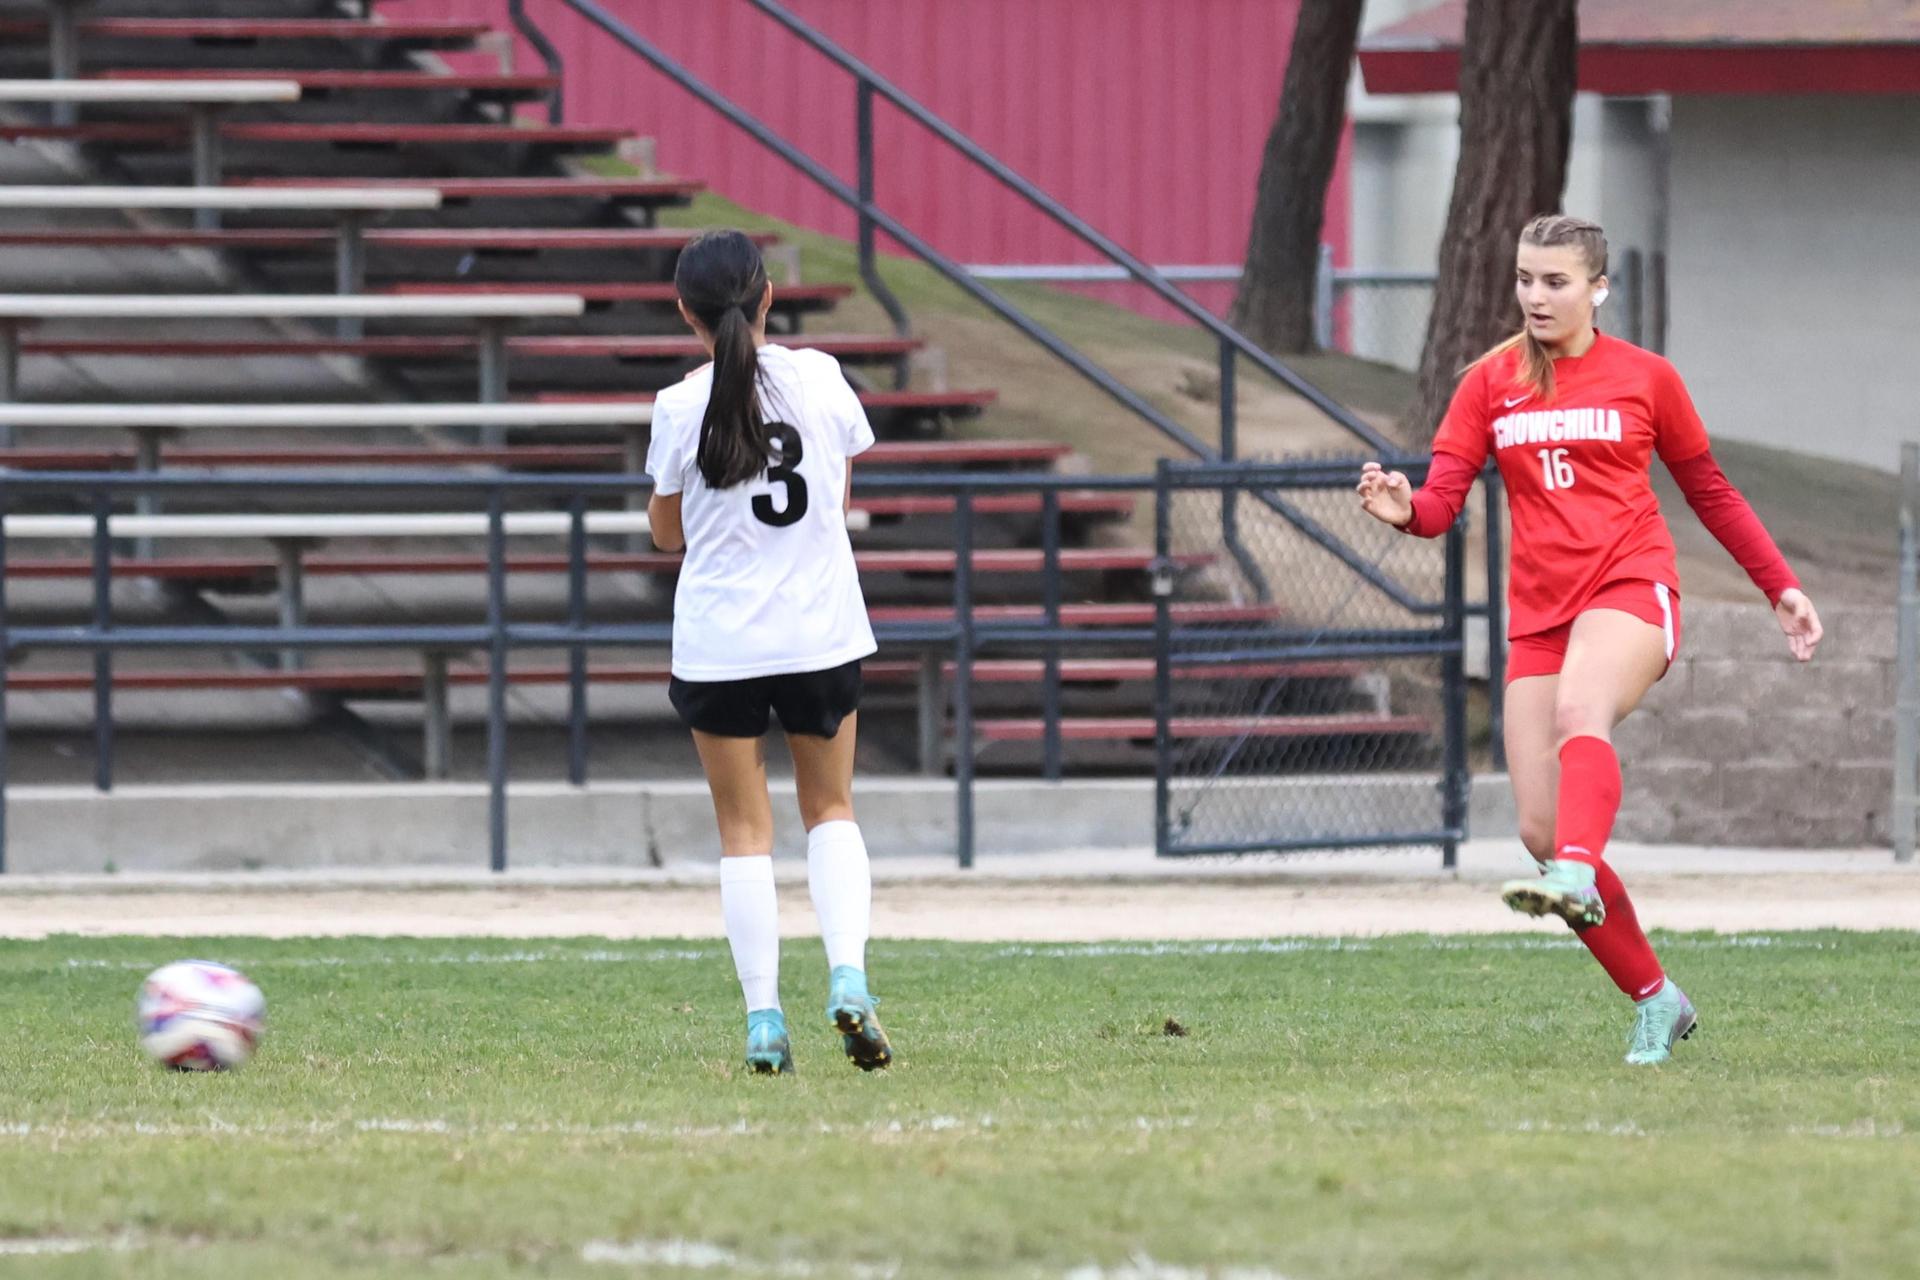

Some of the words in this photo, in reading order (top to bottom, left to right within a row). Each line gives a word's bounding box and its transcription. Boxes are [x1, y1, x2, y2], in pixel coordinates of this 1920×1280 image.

[1492, 408, 1622, 449] CHOWCHILLA
[751, 421, 808, 527] 3
[1537, 448, 1576, 490] 16
